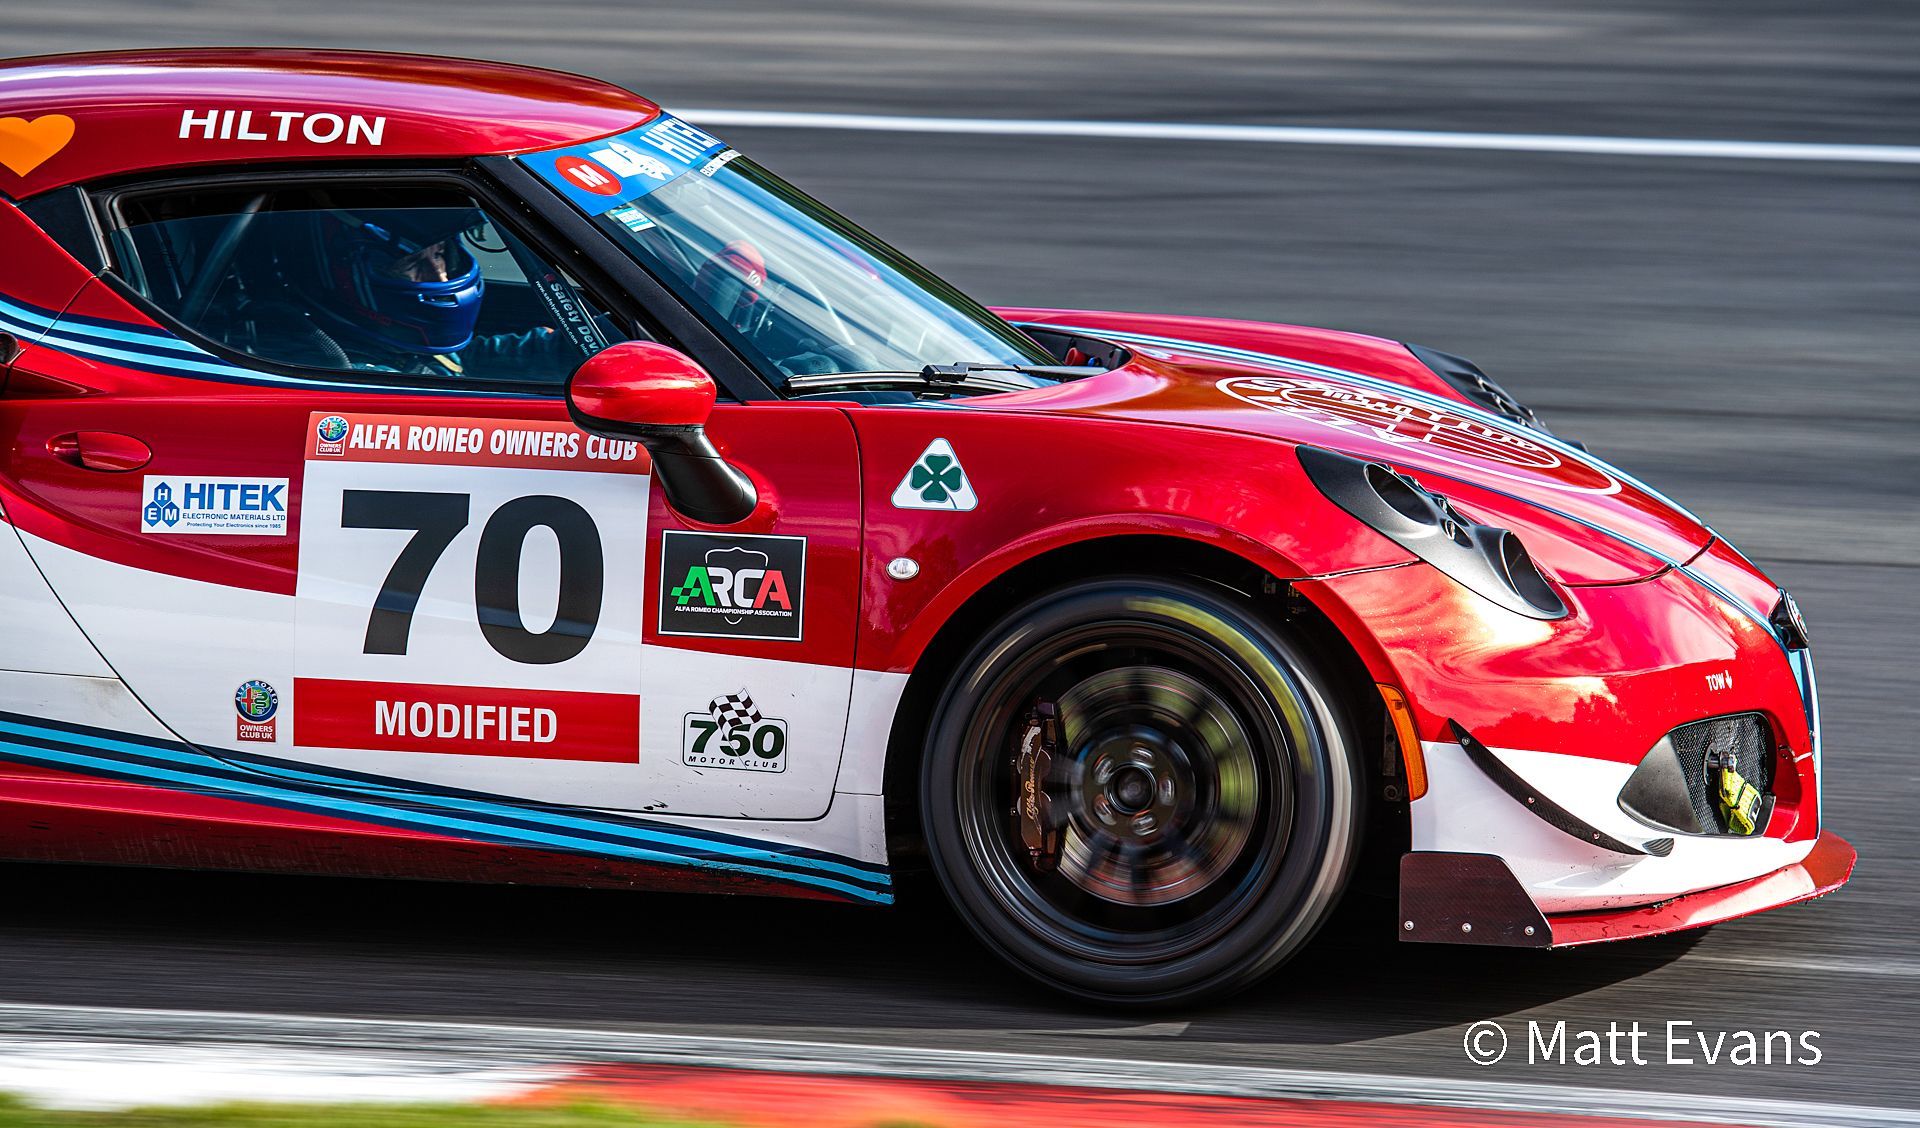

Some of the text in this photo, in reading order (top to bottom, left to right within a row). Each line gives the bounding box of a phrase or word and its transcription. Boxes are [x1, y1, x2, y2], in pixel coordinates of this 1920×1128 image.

[179, 109, 386, 146] HILTON
[567, 164, 610, 188] M
[551, 283, 582, 323] Safety
[349, 424, 401, 450] ALFA
[407, 426, 483, 454] ROMEO
[489, 430, 580, 458] OWNERS
[585, 434, 638, 461] CLUB
[157, 488, 168, 501] H
[184, 483, 286, 511] HITEK
[182, 512, 228, 520] ELECTRONIC
[230, 513, 271, 521] MATERIALS
[341, 489, 604, 664] 70
[671, 565, 792, 611] ARCA
[711, 607, 754, 615] CHAMPIONSHIP
[754, 609, 793, 617] ASSOCIATION
[235, 682, 251, 701] ALFA
[1705, 673, 1725, 691] TOW
[375, 700, 557, 743] MODIFIED
[689, 720, 785, 759] 750
[688, 755, 778, 769] MOTOR CLUB
